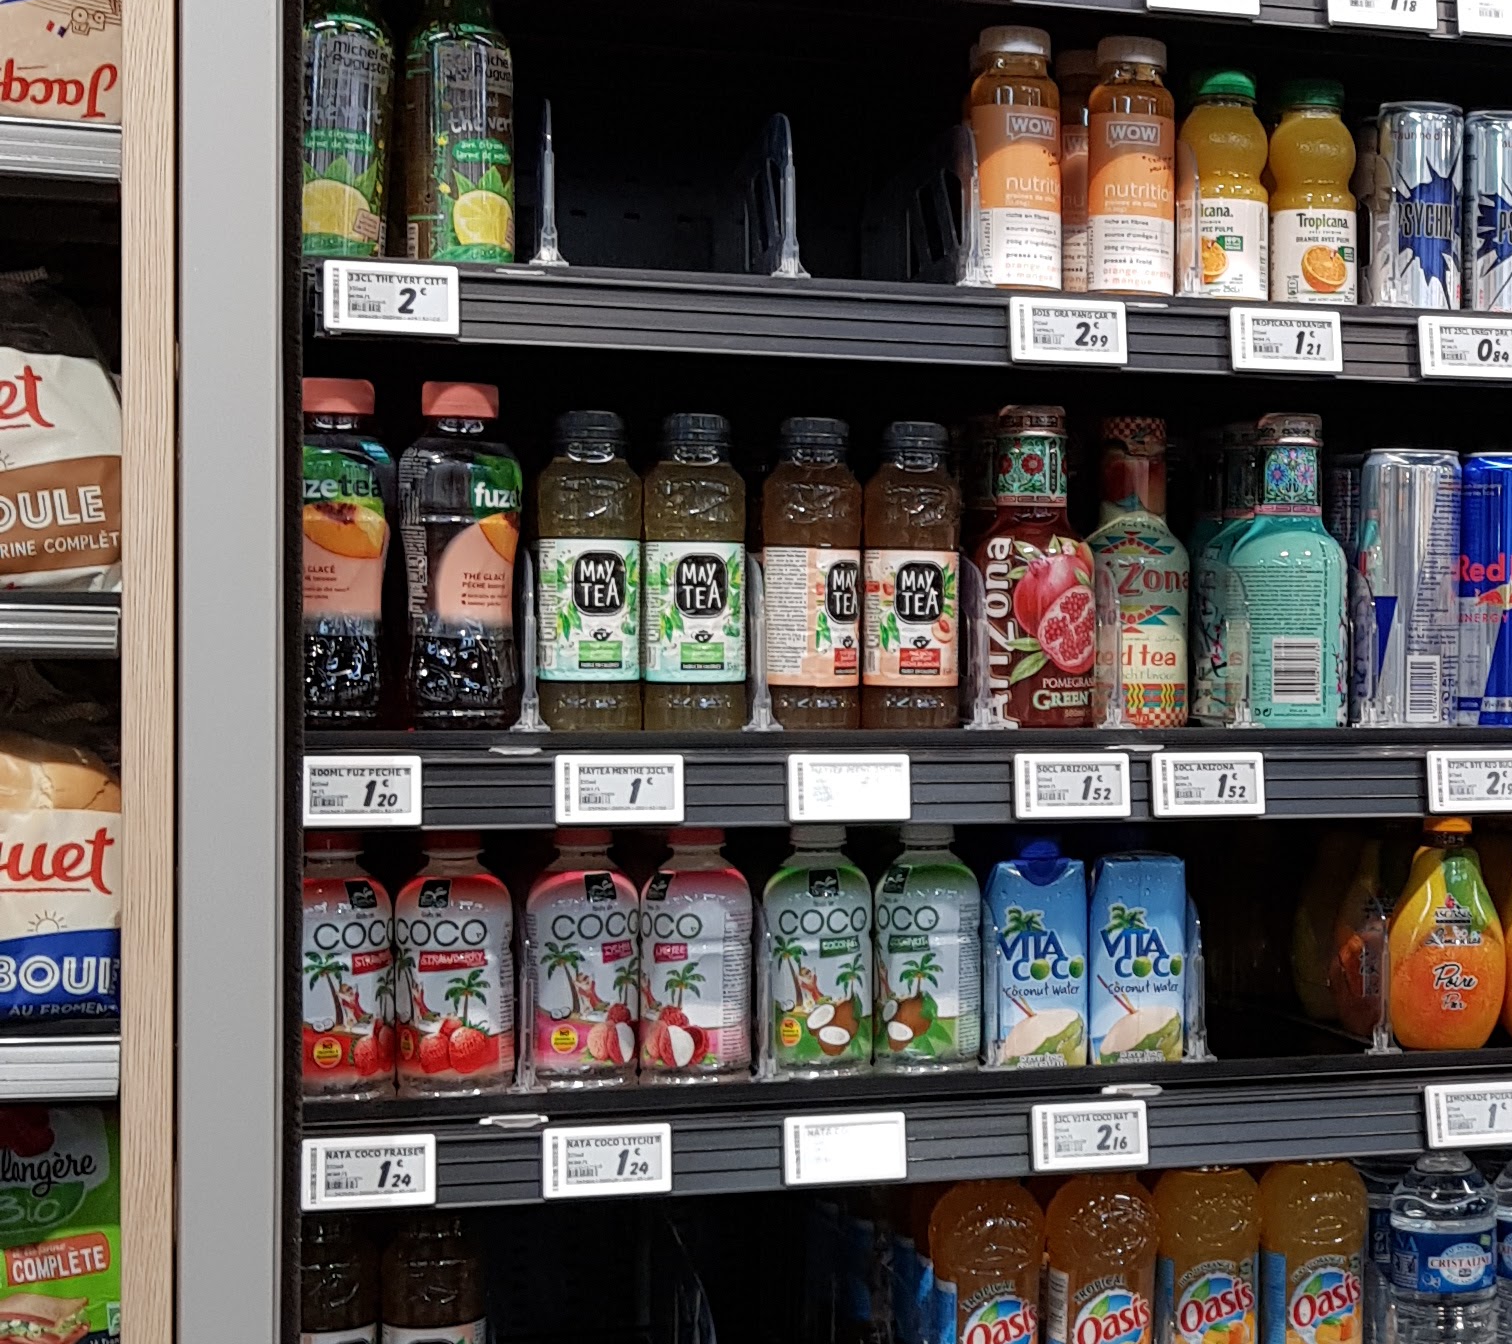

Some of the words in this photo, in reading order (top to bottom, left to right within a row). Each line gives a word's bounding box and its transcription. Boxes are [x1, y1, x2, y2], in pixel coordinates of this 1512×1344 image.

[1009, 114, 1055, 136] WOW
[1108, 122, 1159, 144] WOW
[1296, 213, 1349, 229] Tropicana
[376, 273, 395, 284] THE
[398, 274, 419, 284] VERT
[579, 559, 616, 581] MAY
[681, 563, 718, 585] MAY
[902, 570, 934, 590] MAY
[1456, 553, 1505, 582] Red
[580, 581, 621, 608] TEA
[682, 583, 721, 610] TEA
[903, 590, 940, 616] TEA
[1142, 645, 1176, 667] tea
[1032, 689, 1089, 710] GREEN
[1058, 764, 1100, 774] ARIZONA
[779, 906, 867, 935] COCO
[1000, 929, 1063, 962] VITA
[1102, 928, 1161, 958] VITA
[1012, 955, 1084, 982] COCO
[1114, 954, 1182, 979] COCO
[1433, 962, 1478, 992] Poire
[325, 1149, 351, 1160] NATA
[355, 1148, 380, 1158] COCO
[12, 1245, 107, 1284] COMPLÈTE
[1179, 1279, 1254, 1333] Oasis
[1293, 1271, 1361, 1328] Oasis
